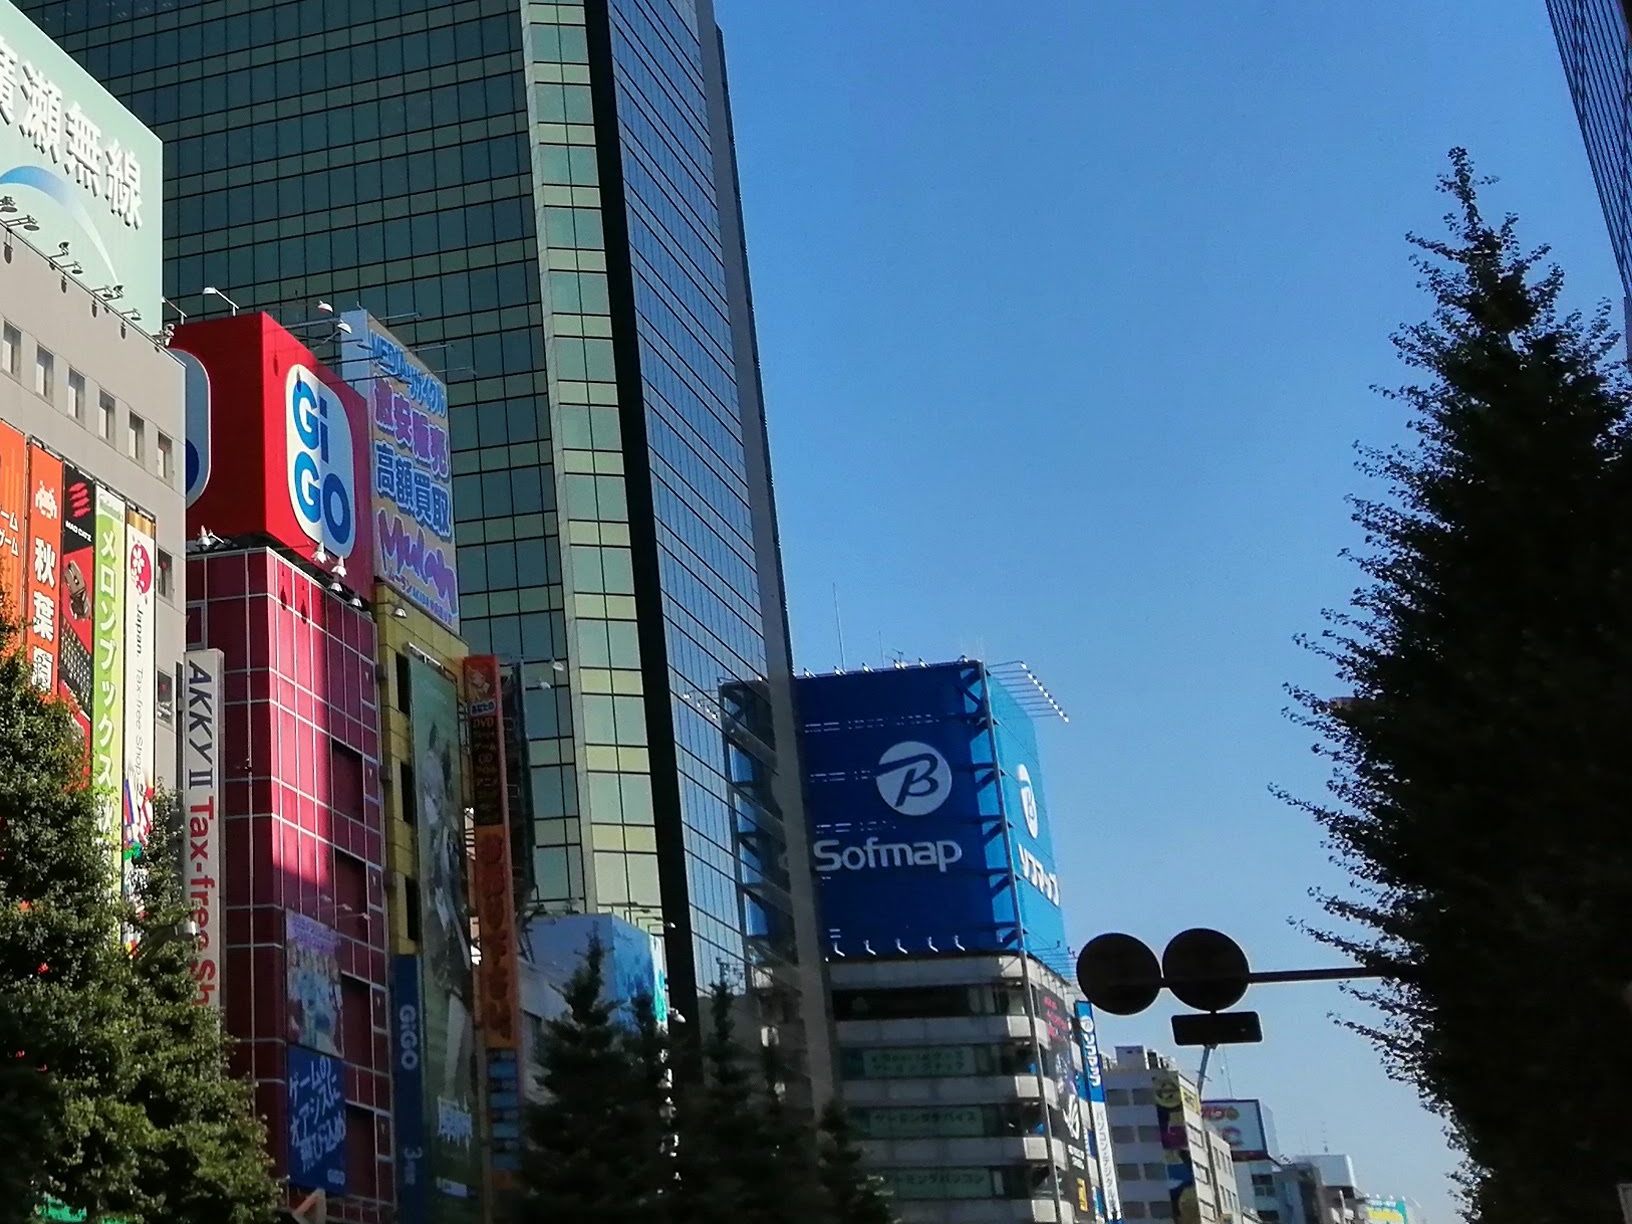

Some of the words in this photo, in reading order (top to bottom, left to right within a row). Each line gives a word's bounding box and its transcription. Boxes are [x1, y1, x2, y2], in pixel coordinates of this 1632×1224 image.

[375, 440, 451, 537] 高額買取
[31, 536, 57, 694] 秋葉原
[187, 659, 214, 766] AKKY
[813, 837, 962, 873] Sofmap
[399, 1005, 417, 1071] GiGO
